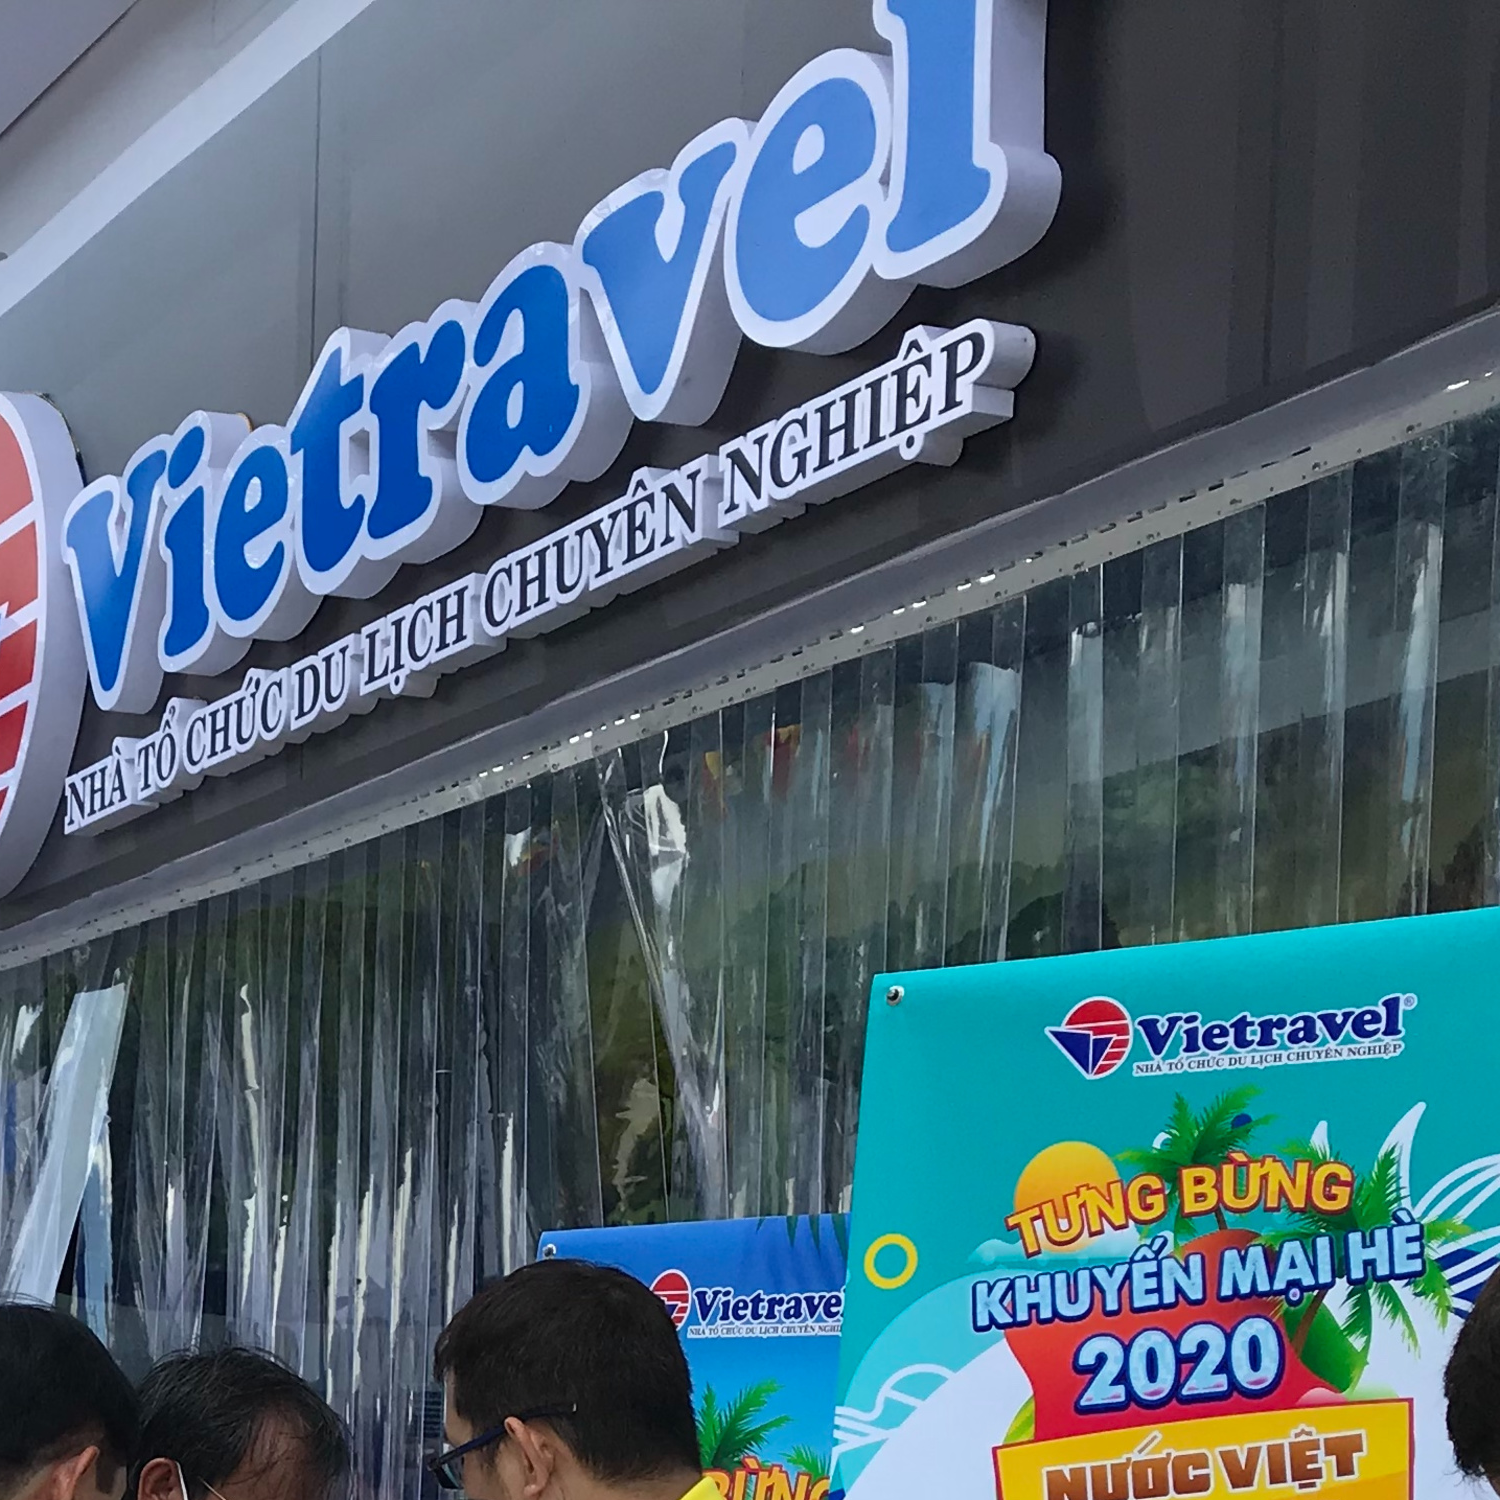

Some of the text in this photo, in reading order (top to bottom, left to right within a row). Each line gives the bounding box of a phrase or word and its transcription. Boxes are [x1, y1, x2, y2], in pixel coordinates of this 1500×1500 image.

[66, 0, 1000, 702] Vietravel
[67, 331, 986, 826] NHÀ TỔ CHỨC DU LỊCH CHUYÊN NGHIỆP
[1134, 1041, 1403, 1075] NHÀ TỔ CHỨC DU LỊCH CHUYÊN NGHIỆP
[1137, 995, 1403, 1056] Vietravel
[1007, 1151, 1353, 1258] TƯNG BỪNG
[694, 1288, 844, 1323] Vietrave
[973, 1209, 1425, 1331] KHUYẾN MẠI HÈ
[1074, 1314, 1284, 1413] 2020
[1218, 1427, 1367, 1493] VIỆT
